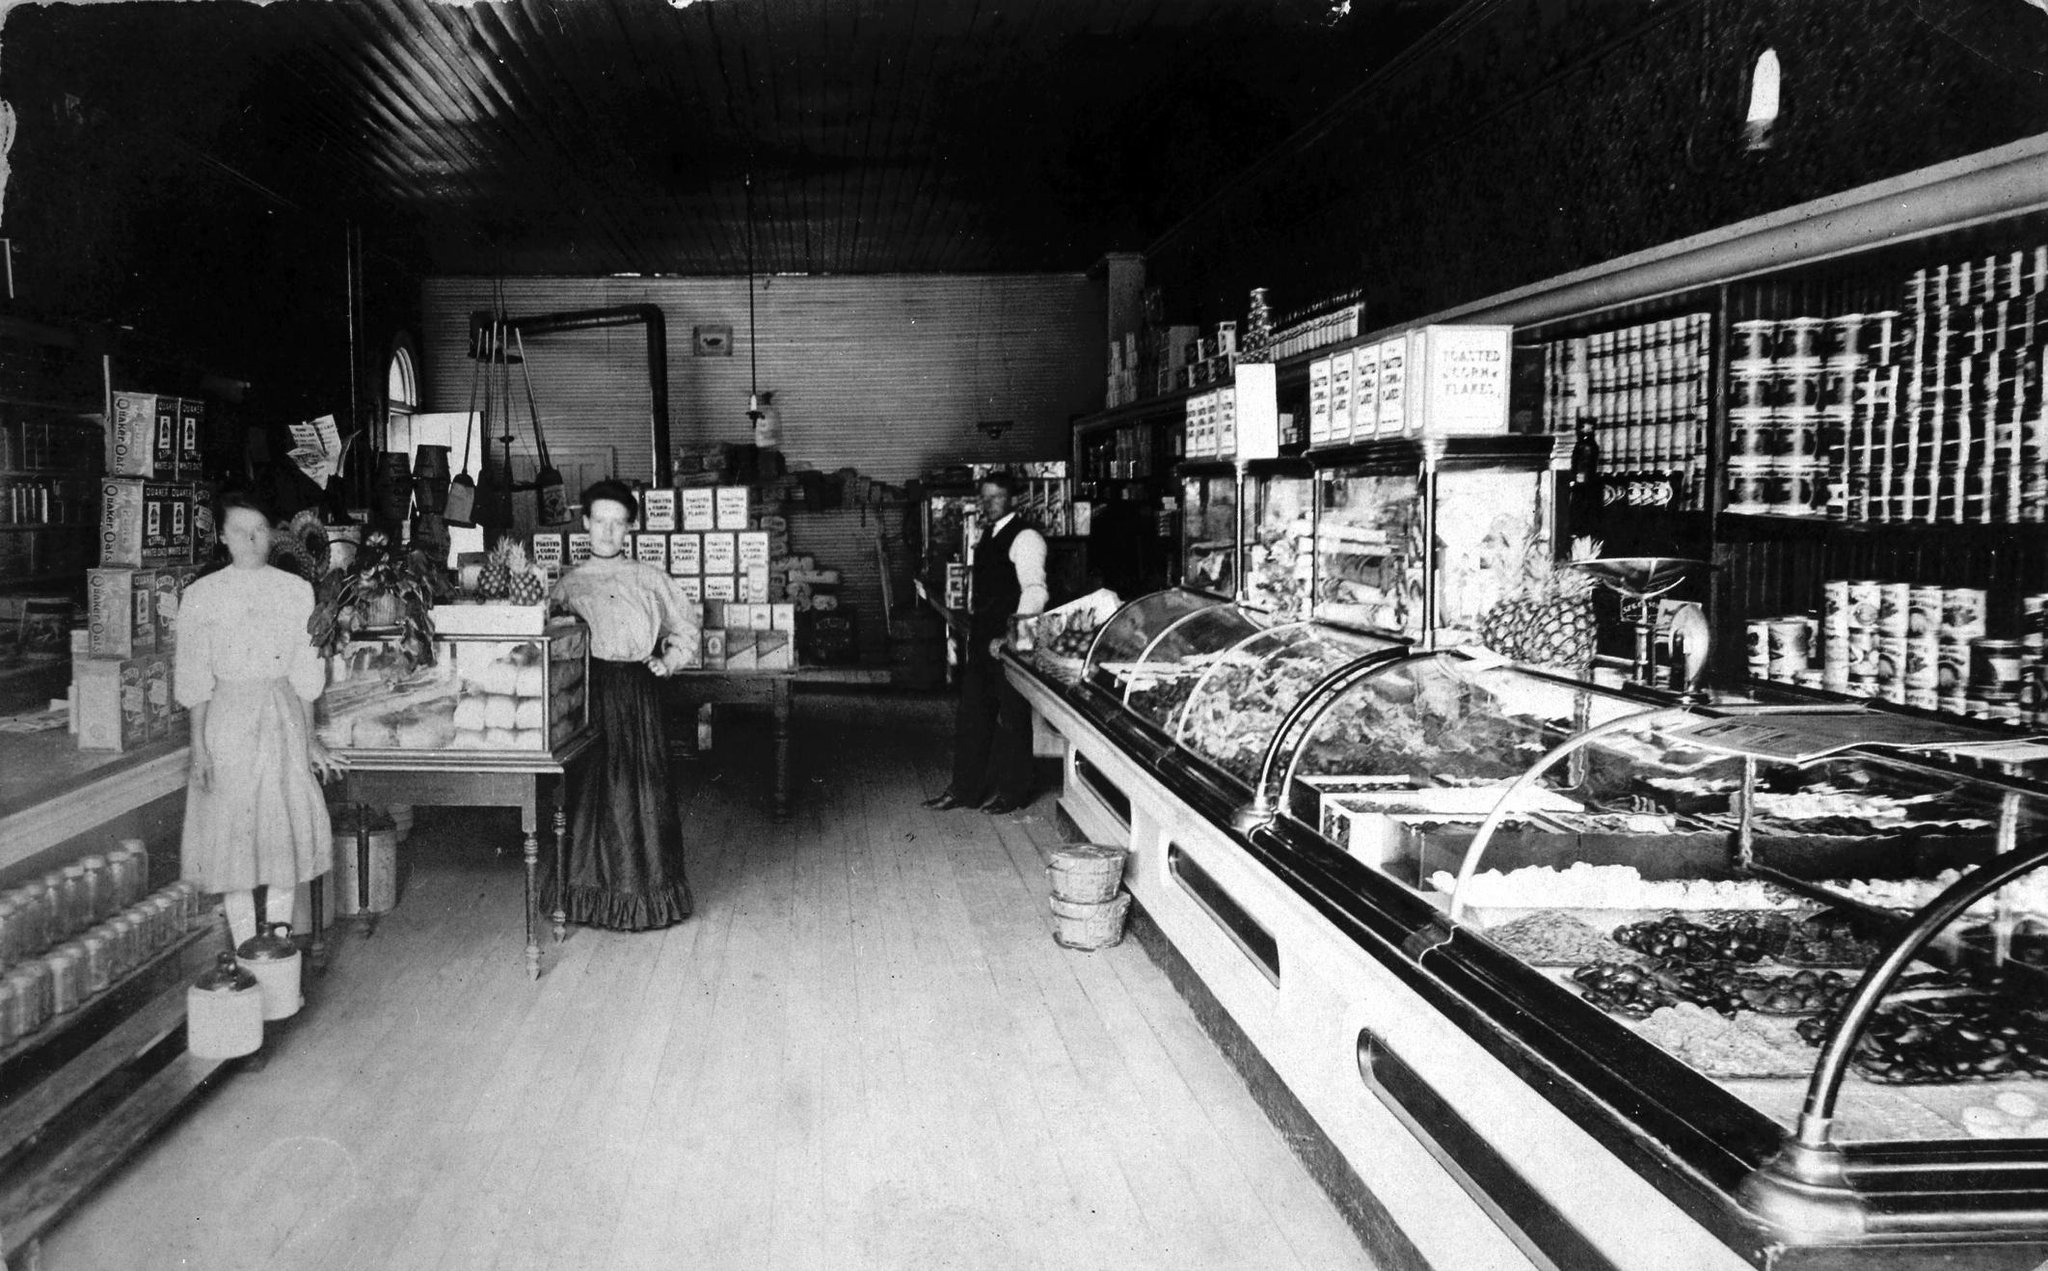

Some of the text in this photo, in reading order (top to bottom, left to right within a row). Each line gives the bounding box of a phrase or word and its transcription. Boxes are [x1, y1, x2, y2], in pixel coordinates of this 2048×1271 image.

[1442, 350, 1500, 362] TOASTED
[115, 398, 130, 474] Quaker Oats
[104, 485, 119, 561] Quaker Oats
